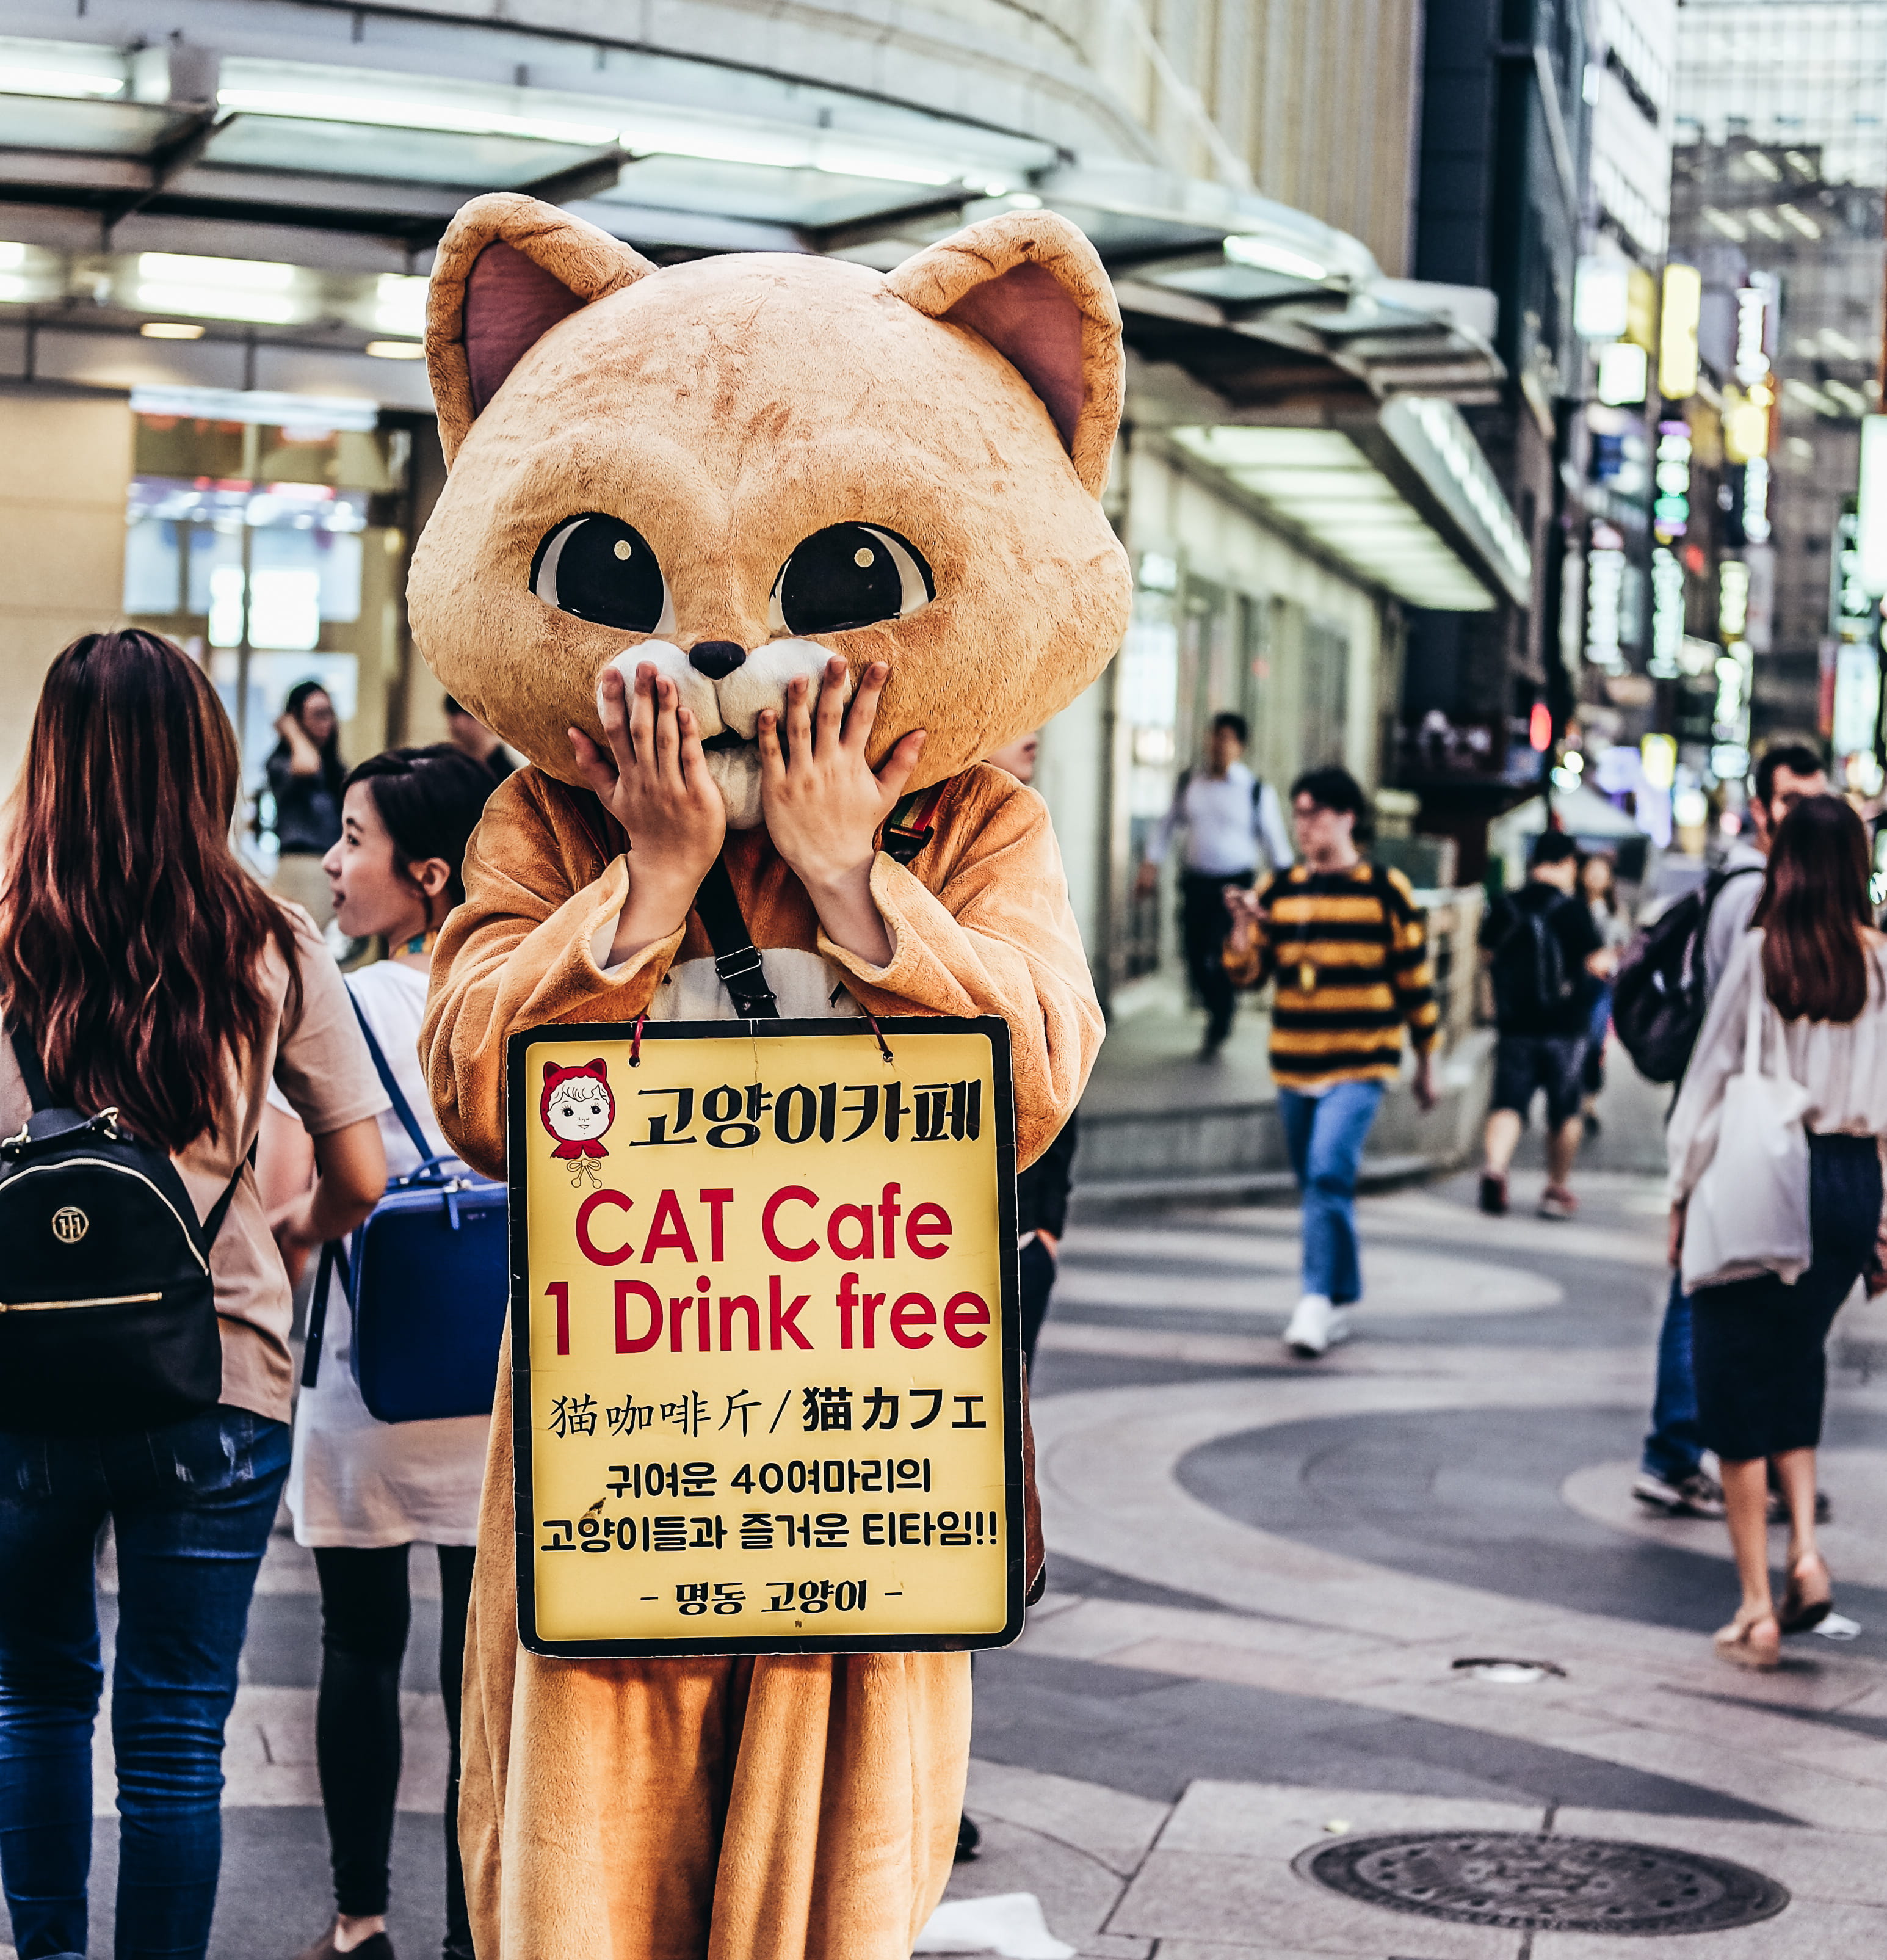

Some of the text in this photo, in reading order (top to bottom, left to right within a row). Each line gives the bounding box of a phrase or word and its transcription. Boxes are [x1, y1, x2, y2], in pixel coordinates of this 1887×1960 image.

[629, 1078, 982, 1149] 고양이카페
[576, 1181, 953, 1266] CAT Cafe
[545, 1272, 991, 1355] 1 Drink free
[606, 1458, 930, 1498] 귀여운 40여마리의
[540, 1511, 997, 1553] 고양이들과 즐거운 티타임!!
[675, 1581, 747, 1616] 명동
[761, 1579, 867, 1613] 고양이
